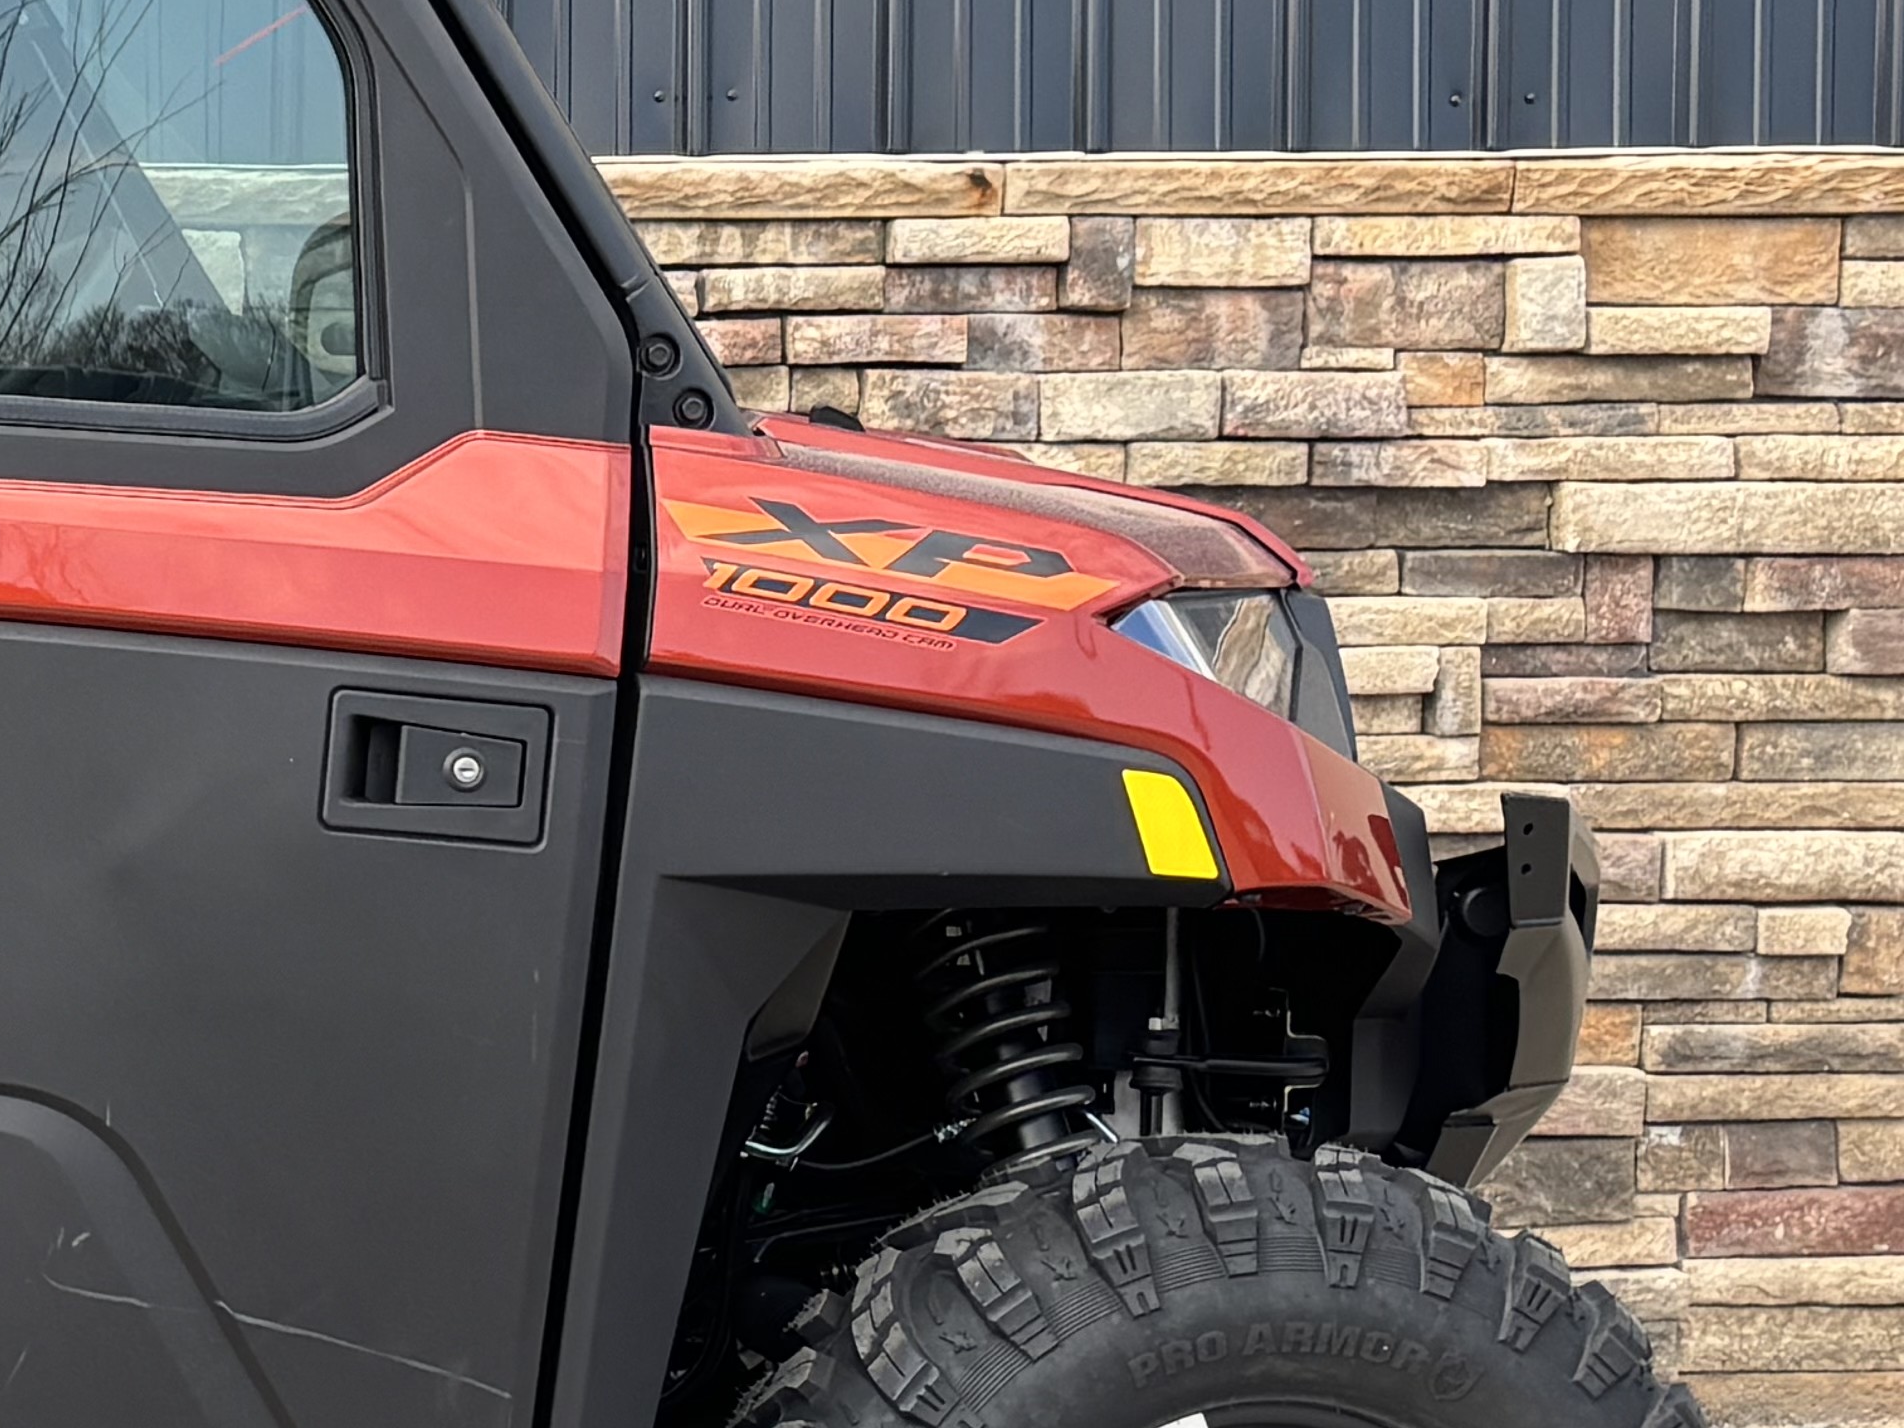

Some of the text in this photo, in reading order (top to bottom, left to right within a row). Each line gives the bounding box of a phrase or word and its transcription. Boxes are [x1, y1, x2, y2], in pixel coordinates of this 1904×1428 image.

[697, 496, 1076, 578] XP
[703, 562, 966, 631] 1000
[703, 597, 954, 651] DUAL OVERHEAD CAM
[1126, 1321, 1430, 1389] PRO ARMOR
